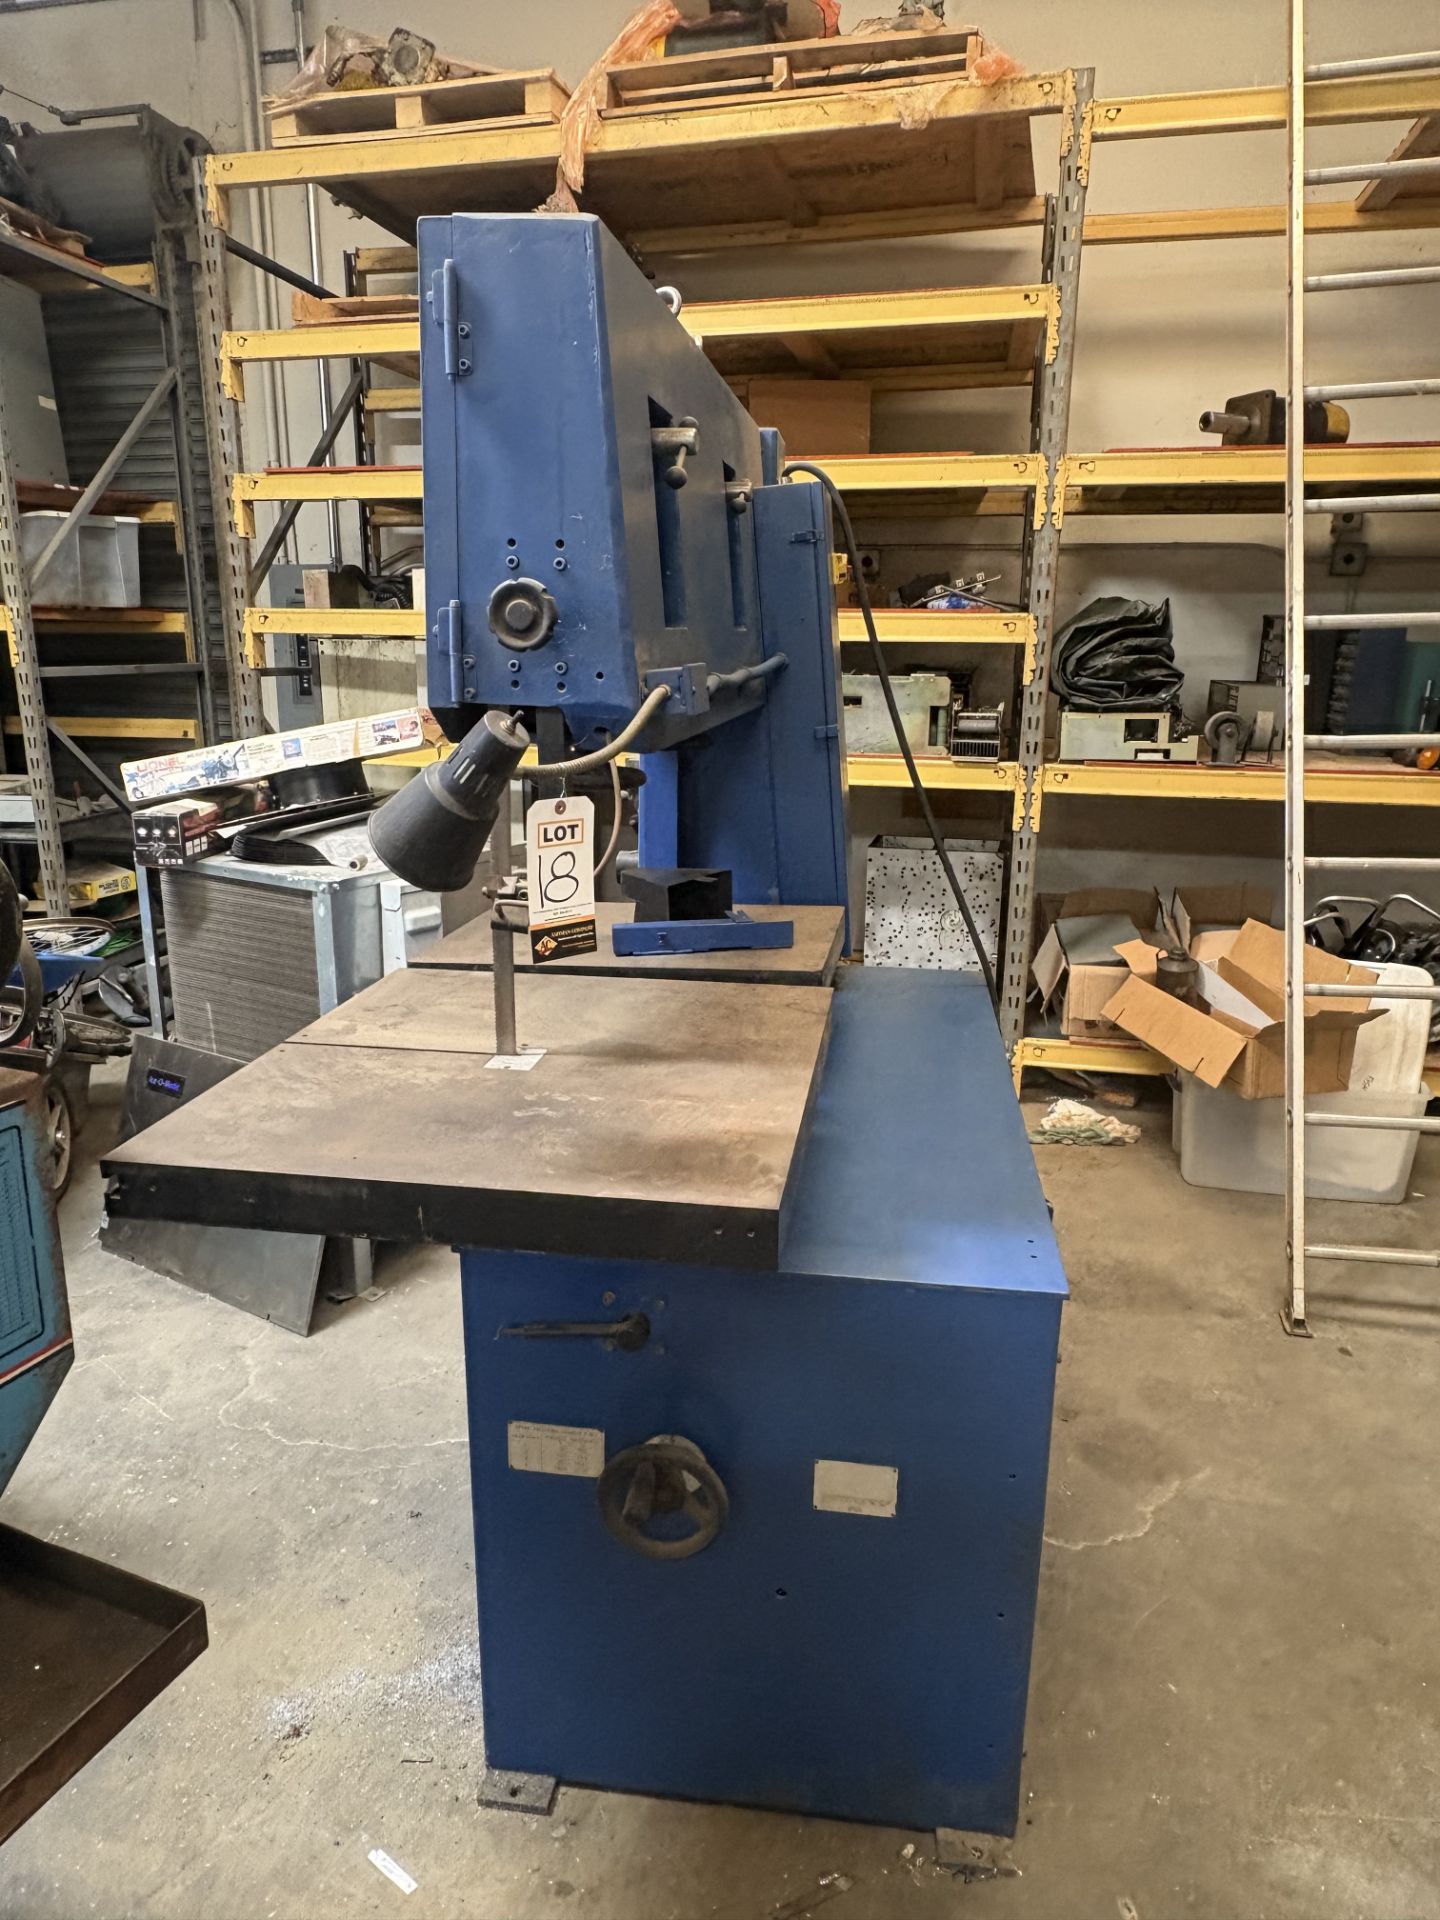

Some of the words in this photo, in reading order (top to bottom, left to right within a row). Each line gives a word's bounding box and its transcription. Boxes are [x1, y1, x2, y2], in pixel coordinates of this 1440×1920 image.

[136, 757, 185, 773] LIONEL
[543, 824, 579, 843] LOT
[538, 851, 580, 909] 18
